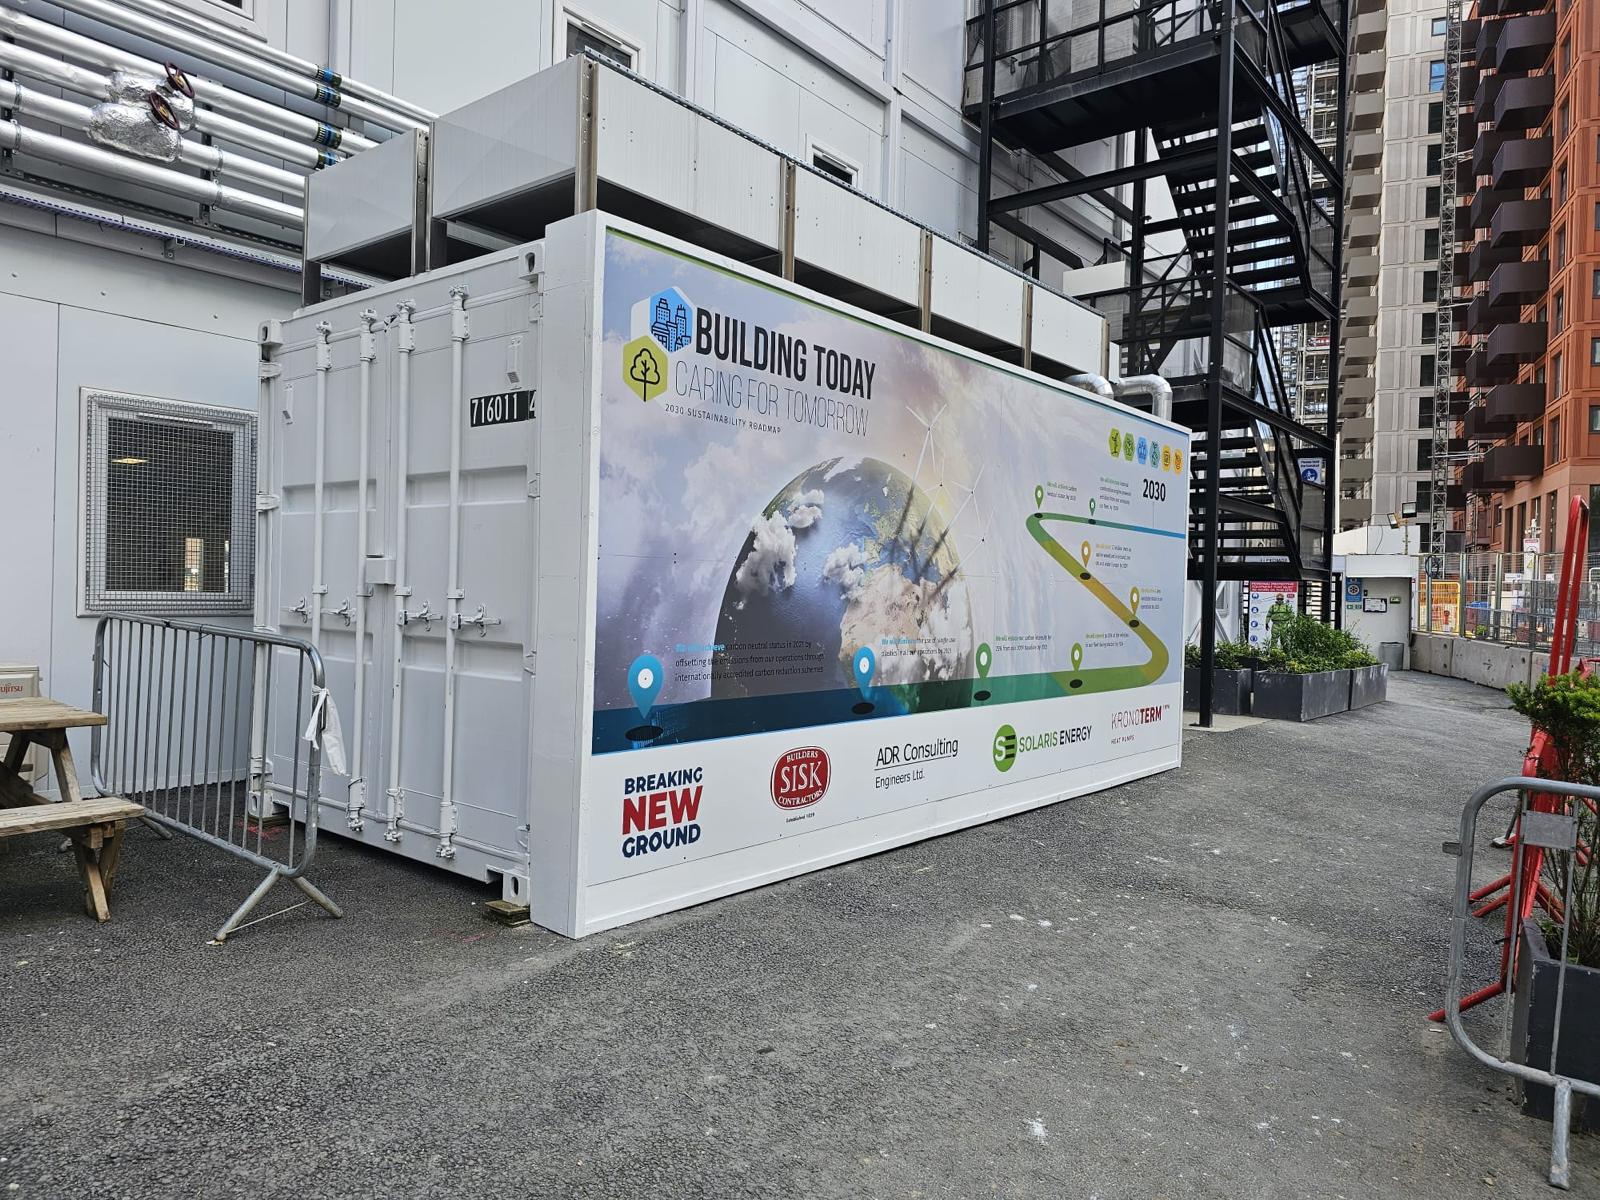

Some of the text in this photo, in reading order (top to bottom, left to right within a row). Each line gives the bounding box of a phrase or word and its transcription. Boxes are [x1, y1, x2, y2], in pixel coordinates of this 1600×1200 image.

[695, 307, 876, 400] BUILDING TODAY
[472, 393, 518, 425] 716011
[675, 360, 869, 437] CARING FOR TOMORROW
[665, 403, 781, 434] 2030 SUSTAINABILITY ROADMAP
[1143, 478, 1166, 501] 2030
[675, 658, 707, 668] offsetting
[0, 685, 23, 694] UJITSU
[1111, 705, 1162, 730] KRONOTERM
[876, 738, 959, 767] ADR Consulting
[1018, 731, 1058, 752] SOLARIS
[1059, 725, 1092, 745] ENERGY
[786, 750, 819, 763] BUILDERS
[624, 767, 703, 795] BREAKING
[780, 761, 822, 793] SISK
[875, 768, 925, 789] Engineers Ltd.
[622, 785, 704, 836] NEW
[778, 788, 823, 806] CONTRACTORS
[622, 823, 701, 858] GROUND
